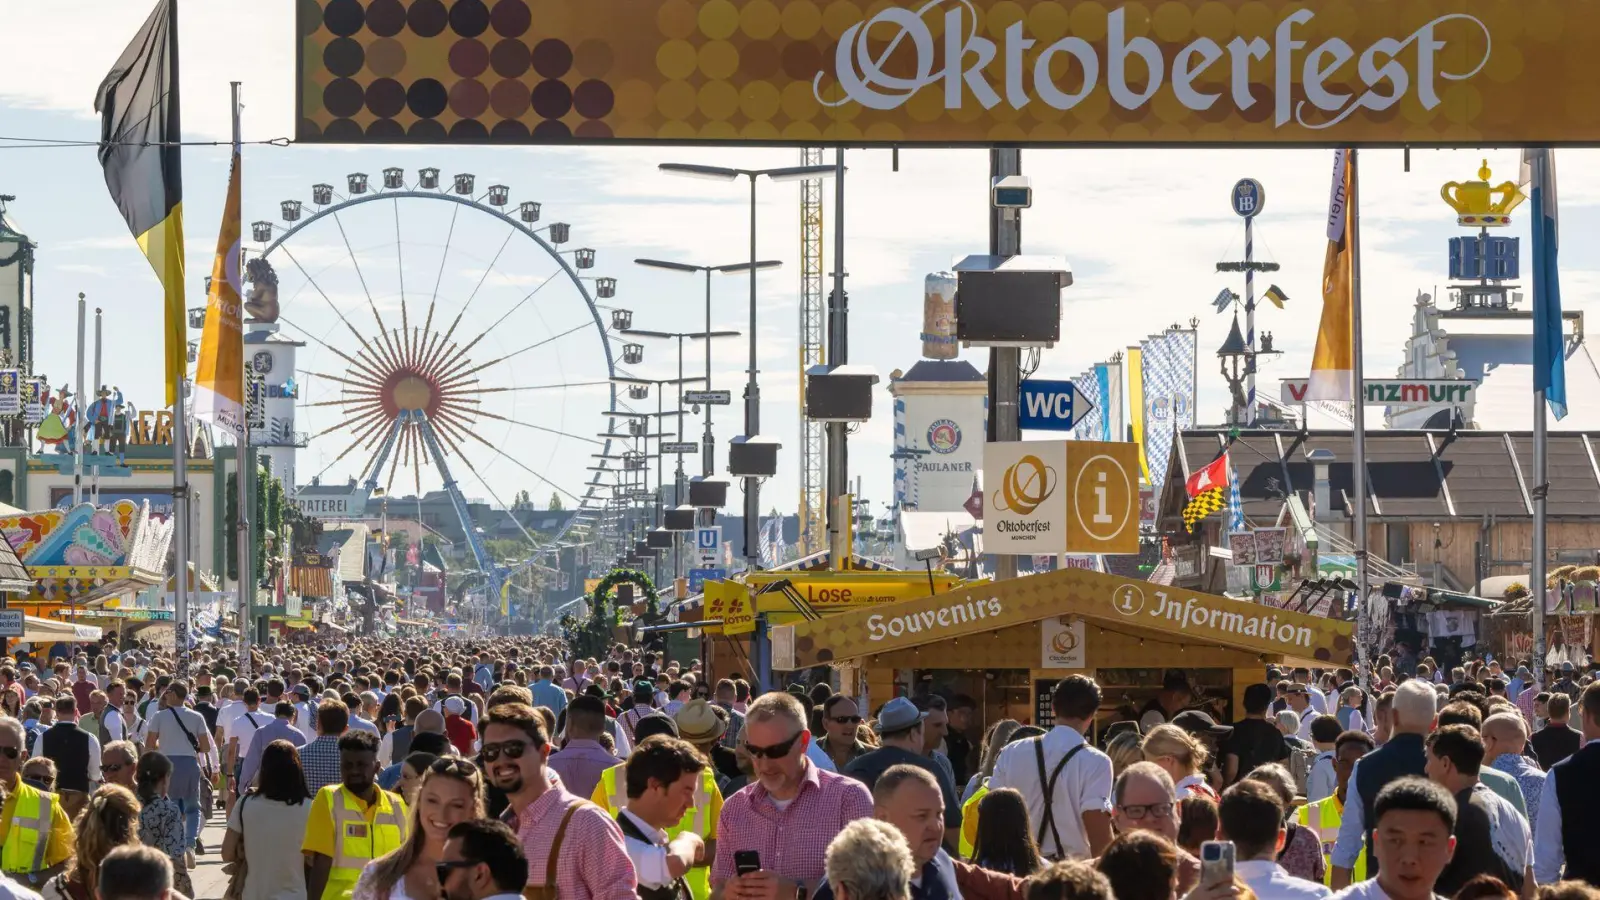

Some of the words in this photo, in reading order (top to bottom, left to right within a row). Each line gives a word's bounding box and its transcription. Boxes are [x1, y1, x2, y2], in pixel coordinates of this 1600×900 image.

[812, 0, 1491, 129] Oktoberfest
[1238, 196, 1254, 211] HB
[1025, 391, 1071, 419] WC
[916, 462, 972, 472] PAULANER
[298, 499, 347, 512] RATEREI
[996, 519, 1051, 533] Oktoberfest
[702, 531, 714, 547] U
[808, 584, 852, 602] Lose
[724, 615, 752, 625] LOTTO
[866, 595, 1002, 641] Souvenirs
[1150, 590, 1312, 646] Information
